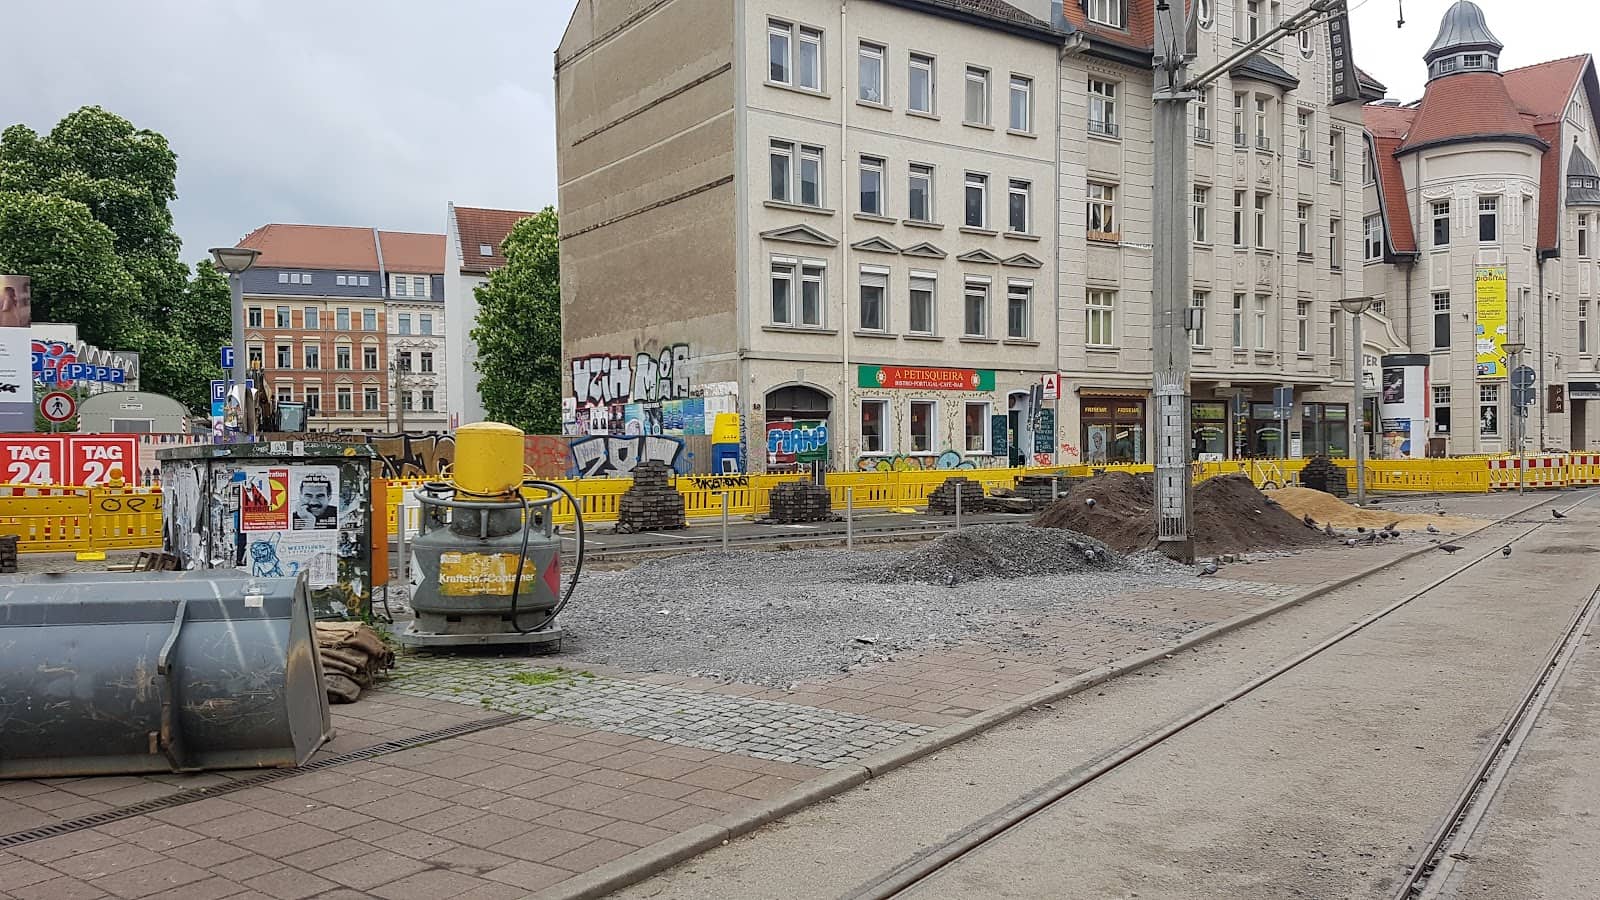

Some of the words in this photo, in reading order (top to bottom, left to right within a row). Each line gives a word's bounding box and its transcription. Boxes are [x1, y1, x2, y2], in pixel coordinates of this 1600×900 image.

[44, 370, 54, 381] P
[72, 365, 83, 378] P
[97, 369, 107, 379] P
[111, 371, 121, 381] P
[895, 369, 902, 379] A
[904, 370, 964, 381] PETISQUEIRA
[6, 445, 51, 460] TAG
[81, 445, 123, 460] TAG
[7, 461, 53, 485] 24
